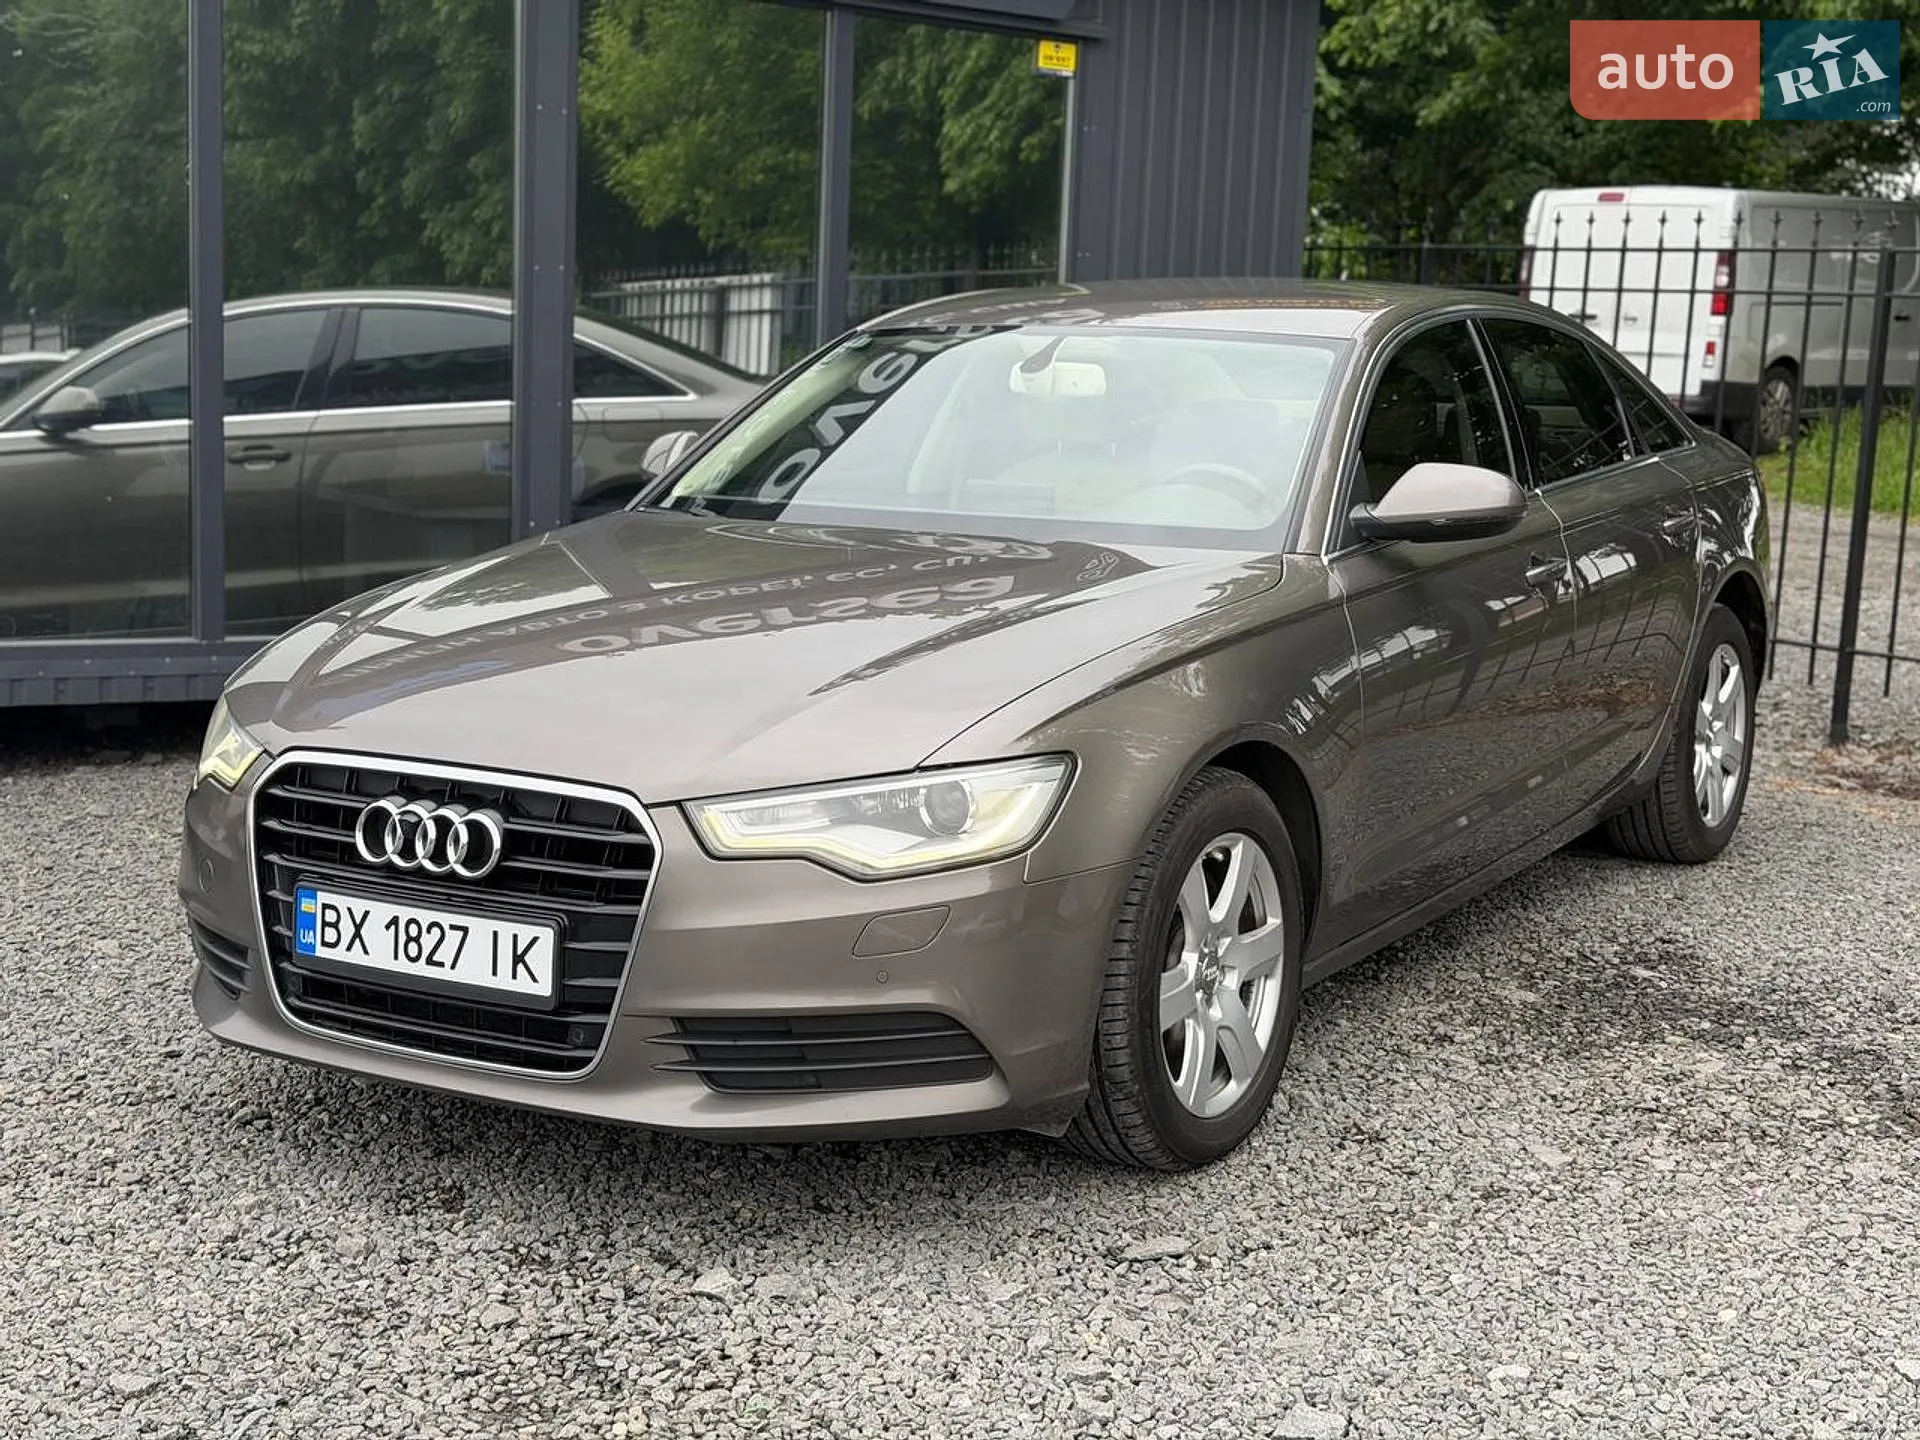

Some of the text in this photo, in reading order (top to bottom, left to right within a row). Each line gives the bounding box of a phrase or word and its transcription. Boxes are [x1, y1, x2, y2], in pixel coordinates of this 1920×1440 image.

[300, 929, 315, 945] UA
[320, 902, 371, 956] BX
[384, 914, 470, 971] 1827
